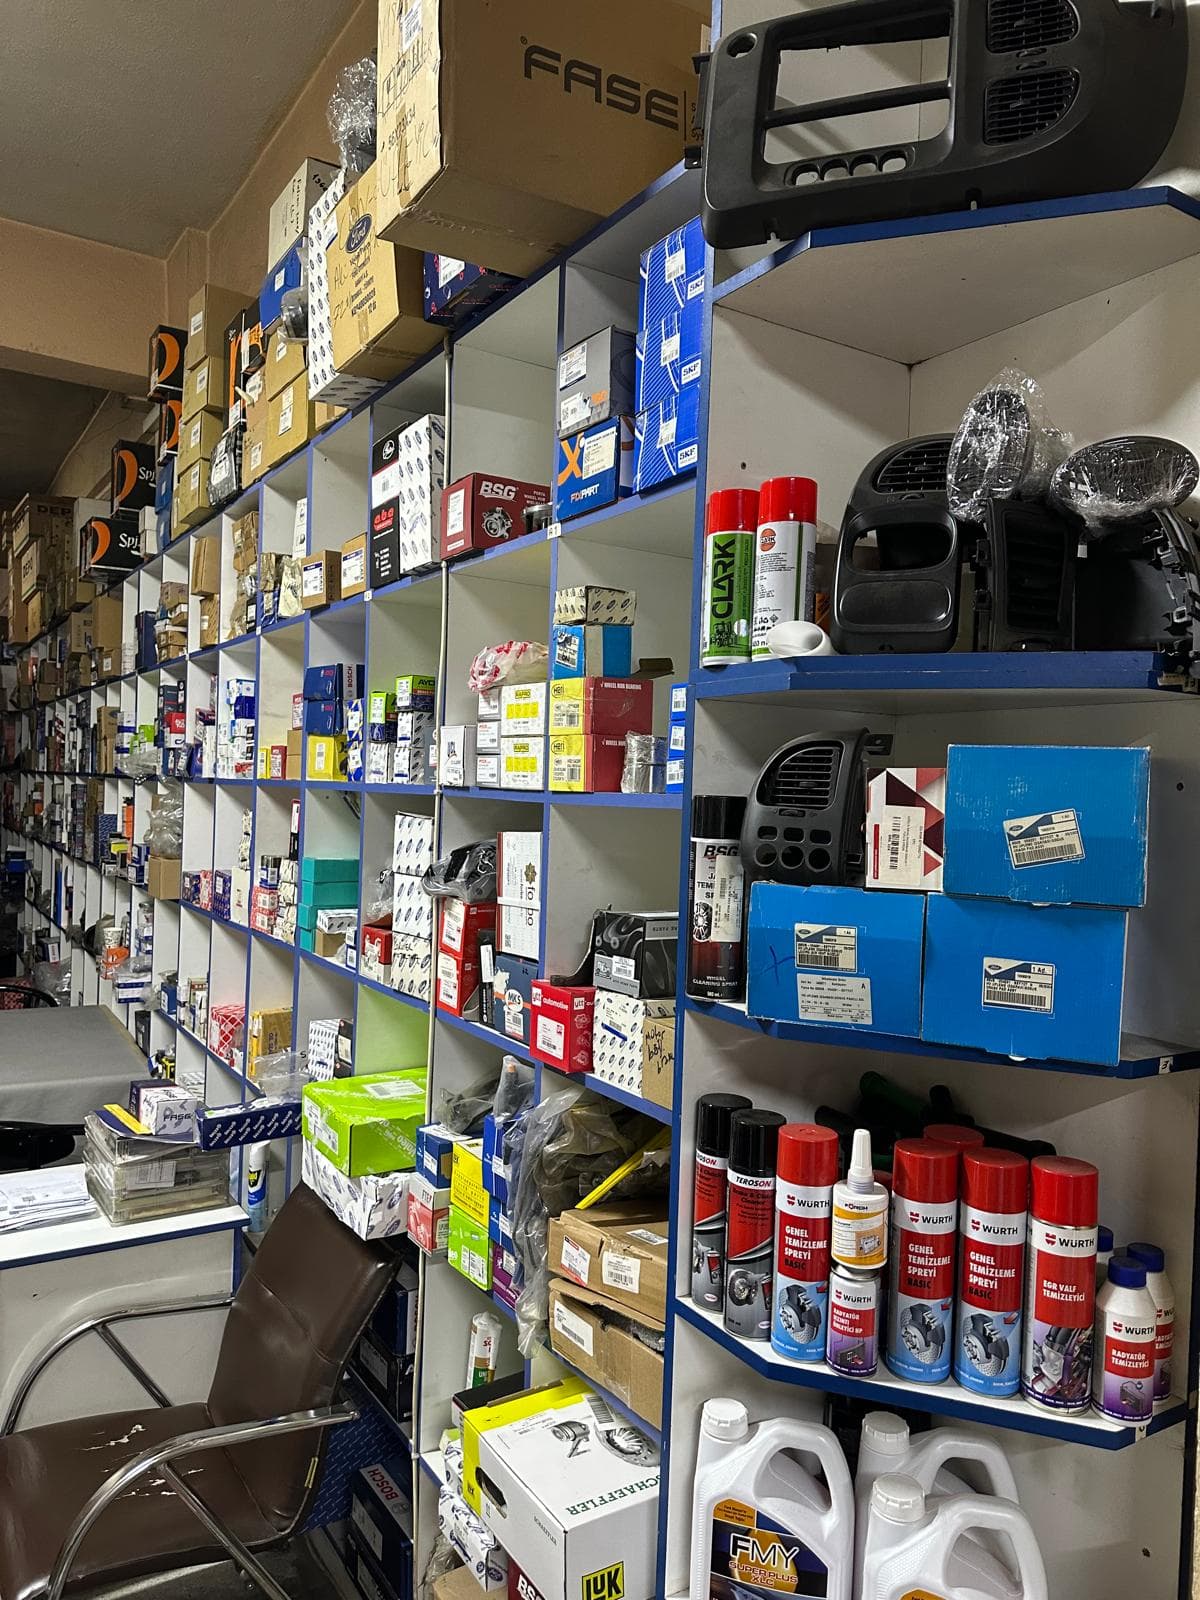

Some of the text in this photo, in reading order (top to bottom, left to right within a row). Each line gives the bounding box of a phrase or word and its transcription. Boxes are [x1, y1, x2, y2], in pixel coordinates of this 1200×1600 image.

[523, 44, 680, 131] FASE
[683, 362, 699, 376] SKF
[679, 447, 695, 462] SKF
[480, 481, 517, 501] BSG
[712, 537, 736, 619] CLARK
[704, 844, 739, 858] BSG
[507, 991, 521, 1003] MKS
[542, 997, 569, 1011] automotive
[574, 999, 584, 1008] utt
[735, 1175, 772, 1188] TEROSON
[741, 1196, 766, 1206] Cleaner
[797, 1199, 831, 1208] WÜRTH
[922, 1215, 953, 1225] WÜRTH
[785, 1225, 809, 1238] GENEL
[983, 1224, 1018, 1235] WÜRTH
[784, 1235, 828, 1250] TEMİZLEME
[908, 1243, 934, 1255] GENEL
[1058, 1238, 1095, 1248] WÜRTH
[784, 1246, 811, 1260] SPREYİ
[908, 1254, 951, 1266] TEMİZLEME
[970, 1251, 996, 1266] GENEL
[907, 1265, 937, 1278] SPREYİ
[969, 1262, 1016, 1278] TEMİZLEME
[969, 1273, 998, 1289] SPREYİ
[1043, 1279, 1077, 1293] EGR VALF
[843, 1293, 872, 1303] WÜRTH
[1042, 1288, 1086, 1303] TEMİZLEYİCİ
[833, 1307, 860, 1320] RADYATÖR
[1111, 1348, 1146, 1360] RADYATÖR
[367, 1467, 399, 1502] BOSCH
[533, 1515, 558, 1546] SCHAEFFLER
[729, 1532, 800, 1569] FMY
[751, 1575, 775, 1587] XLC
